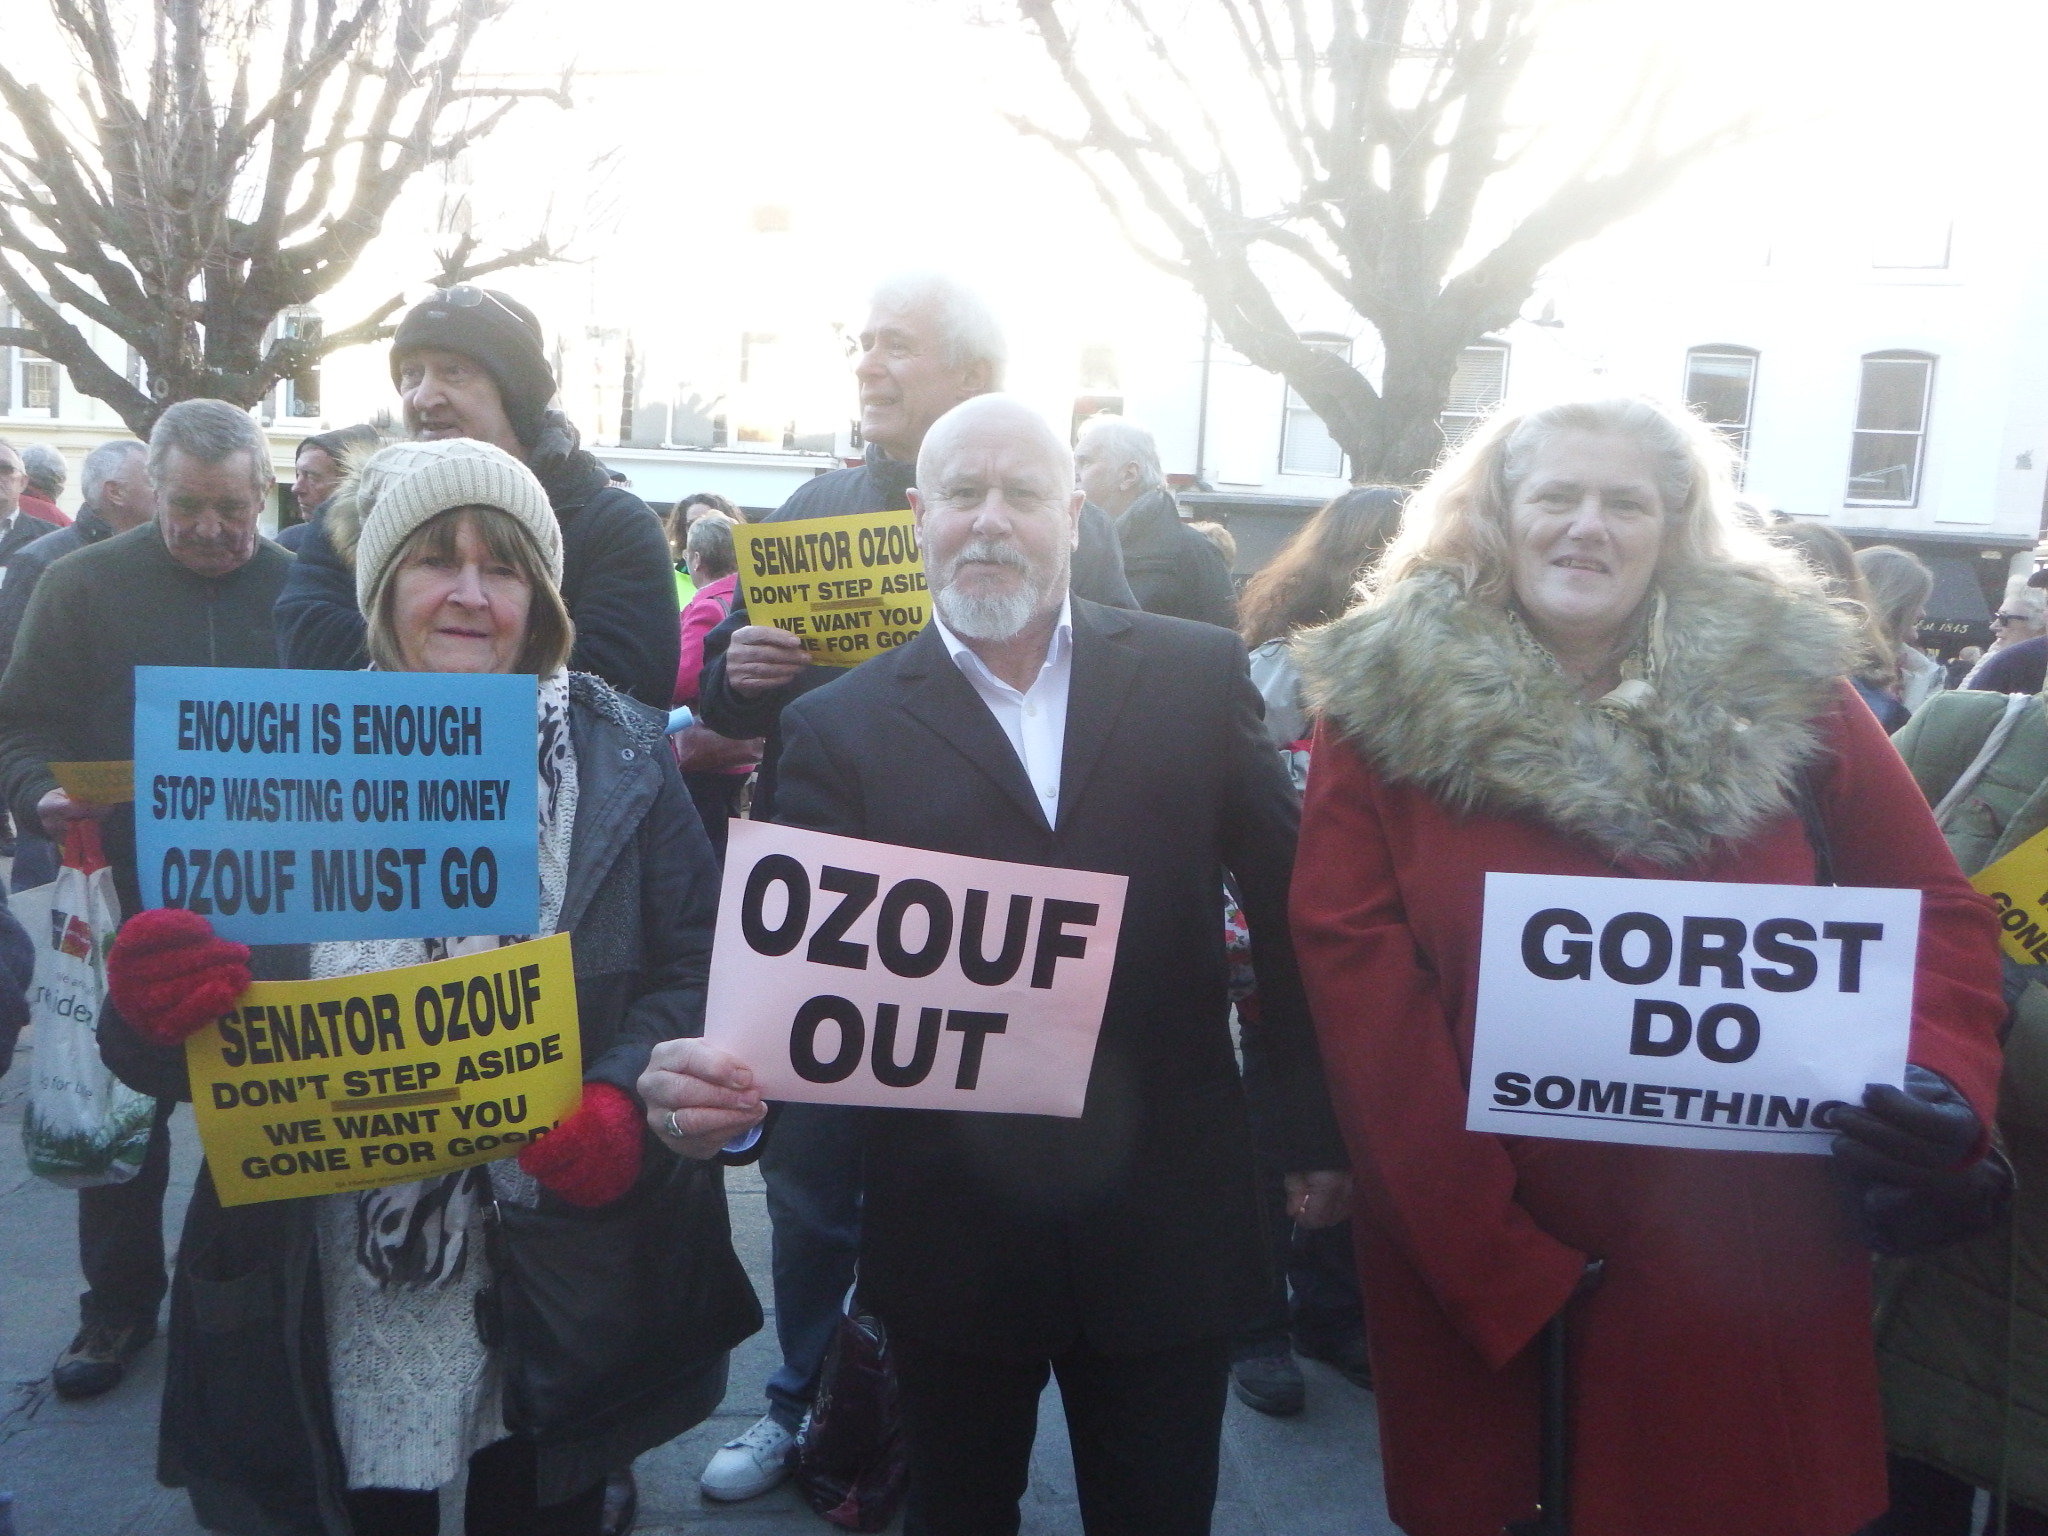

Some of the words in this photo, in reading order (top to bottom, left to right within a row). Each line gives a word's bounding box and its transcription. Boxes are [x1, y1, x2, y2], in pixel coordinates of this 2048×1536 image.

[751, 531, 853, 577] SENATOR
[859, 524, 919, 568] OZOU
[750, 584, 810, 604] DON'T
[818, 578, 873, 600] STEP
[881, 572, 928, 595] ASID
[773, 617, 806, 635] WE
[811, 611, 873, 633] WANT
[879, 606, 923, 626] YOU
[826, 633, 870, 652] FOR
[876, 631, 920, 648] GOO
[178, 700, 300, 754] ENOUGH
[312, 703, 342, 755] IS
[353, 705, 482, 756] ENOUGH
[152, 775, 215, 820] STOP
[223, 778, 343, 822] WASTING
[353, 779, 409, 822] OUR
[419, 779, 510, 822] MONEY
[161, 847, 296, 916] OZOUF
[311, 848, 426, 912] MUST
[440, 847, 498, 909] GO
[741, 854, 1100, 990] OZOUF
[1521, 907, 1884, 994] GORST
[218, 993, 405, 1067] SENATOR
[415, 963, 541, 1047] OZOUF
[789, 994, 1009, 1091] OUT
[1629, 999, 1761, 1064] DO
[212, 1074, 330, 1110] DON'T
[343, 1061, 440, 1097] STEP
[454, 1033, 563, 1085] ASIDE
[263, 1119, 326, 1146] WE
[333, 1109, 440, 1140] WANT
[451, 1094, 527, 1130] YOU
[241, 1147, 350, 1180] GONE
[361, 1140, 436, 1168] FOR
